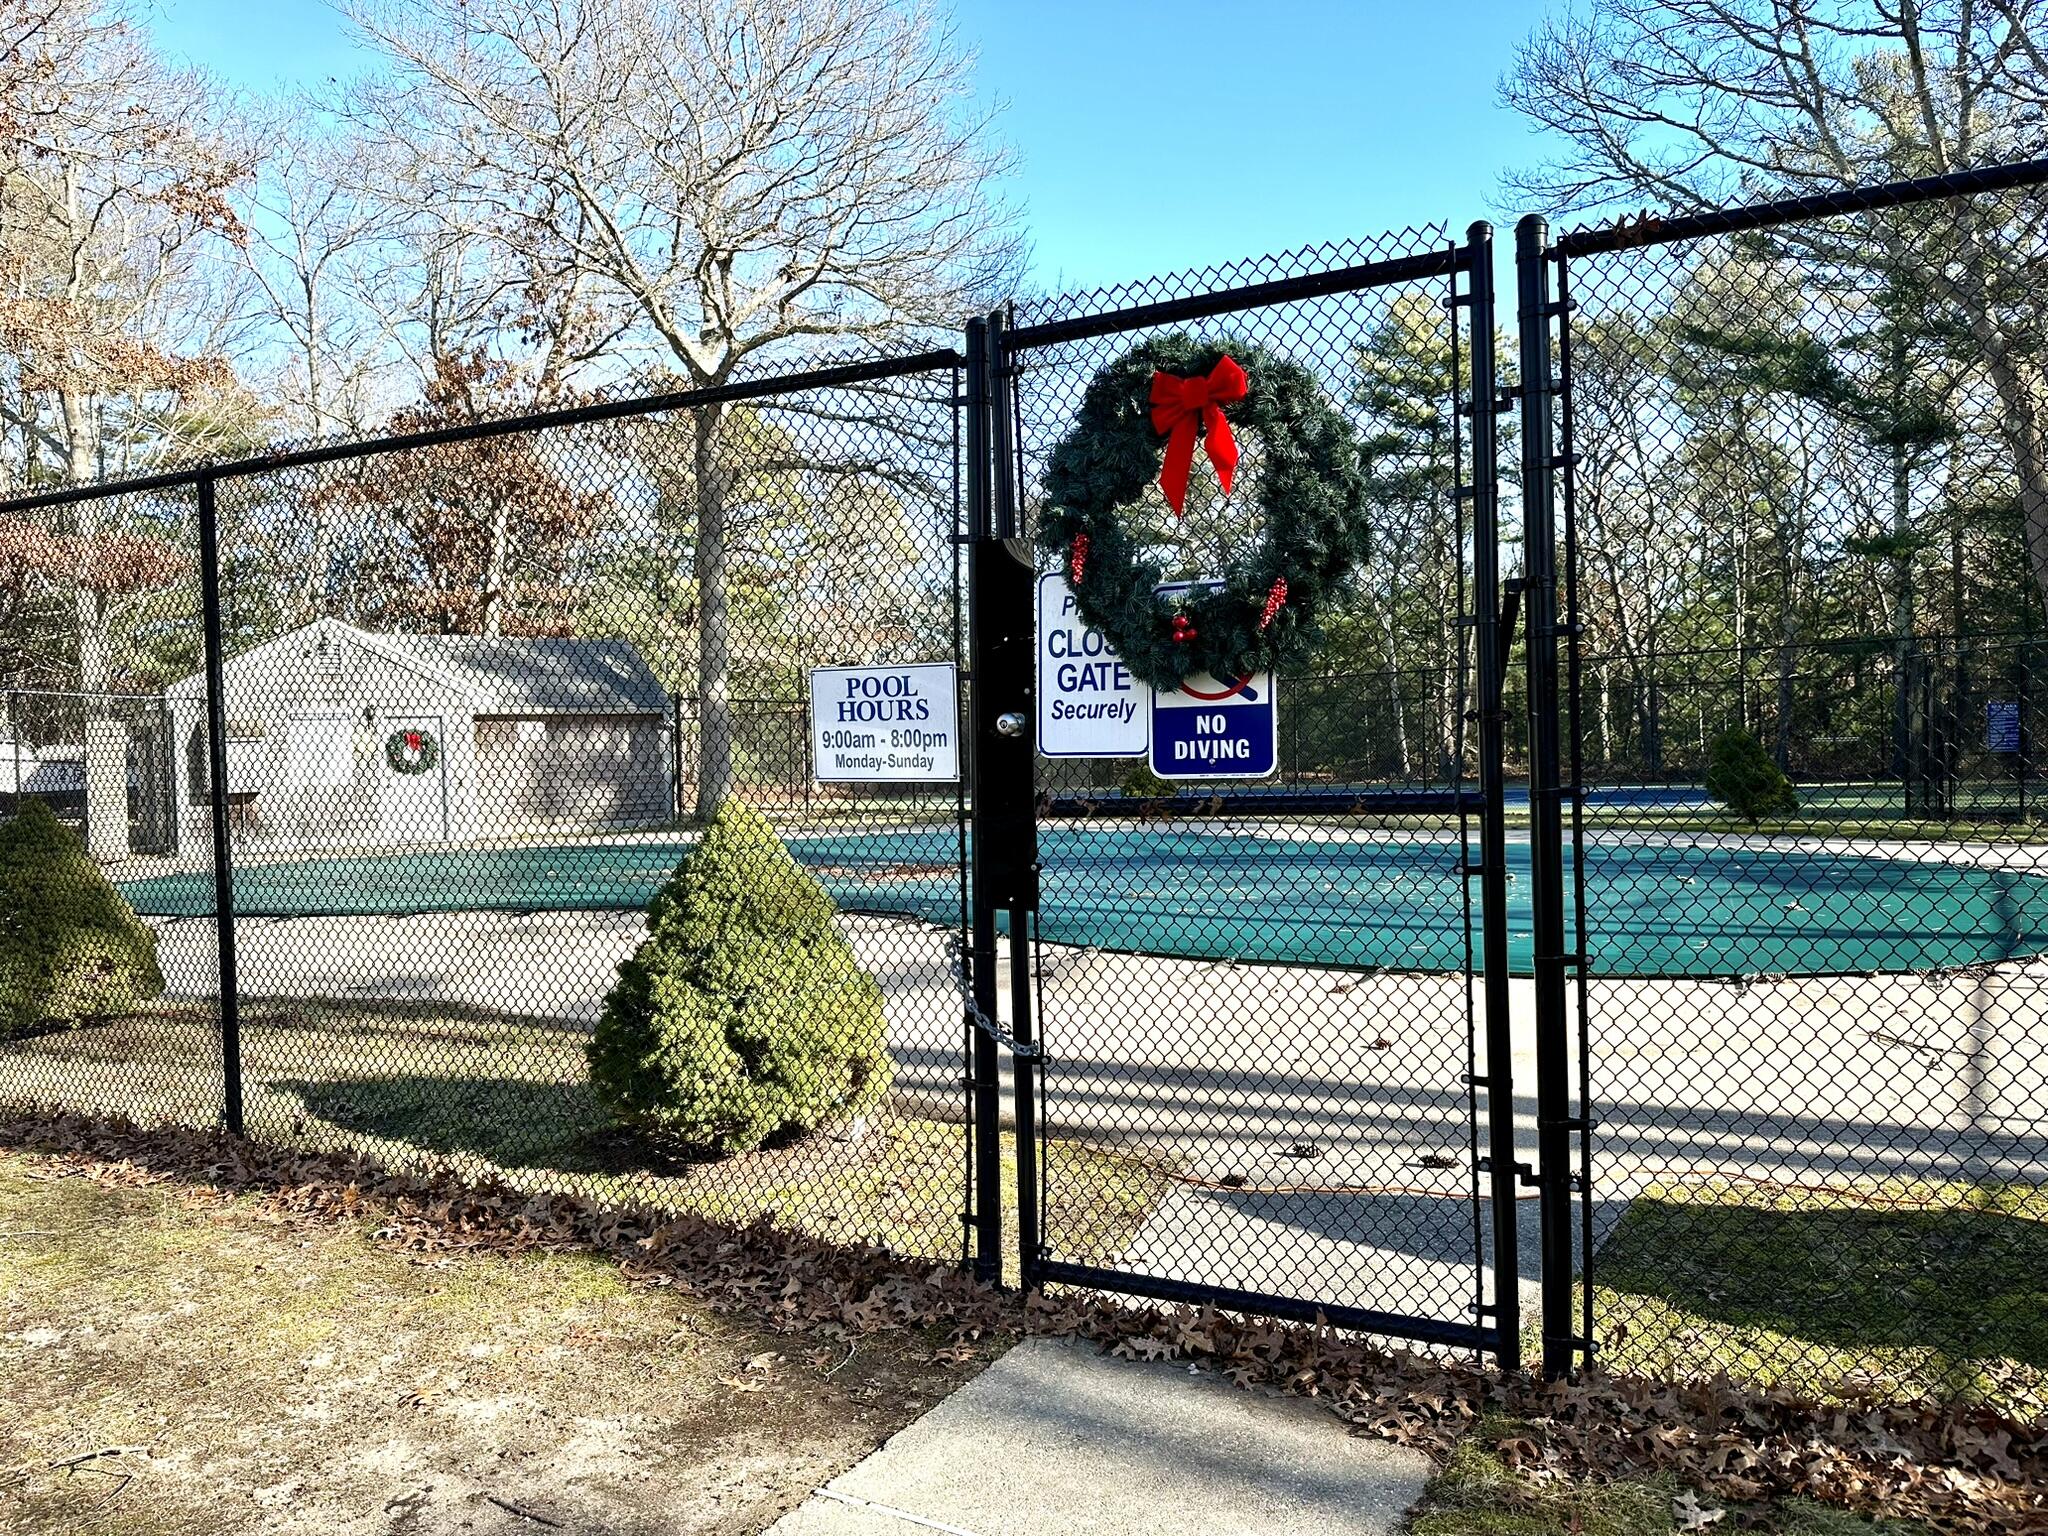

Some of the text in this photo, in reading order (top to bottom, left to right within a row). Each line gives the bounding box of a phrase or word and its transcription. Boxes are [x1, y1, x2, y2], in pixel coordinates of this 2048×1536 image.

[1048, 627, 1117, 659] CLO
[846, 676, 918, 698] POOL
[1057, 662, 1131, 692] GATE
[837, 699, 930, 722] HOURS
[1051, 698, 1137, 724] Securely
[1196, 714, 1227, 734] NO
[822, 730, 876, 748] 9:00am
[891, 729, 948, 752] 8:00pm
[1174, 738, 1250, 760] DIVING
[835, 754, 935, 772] Monday-Sunday
